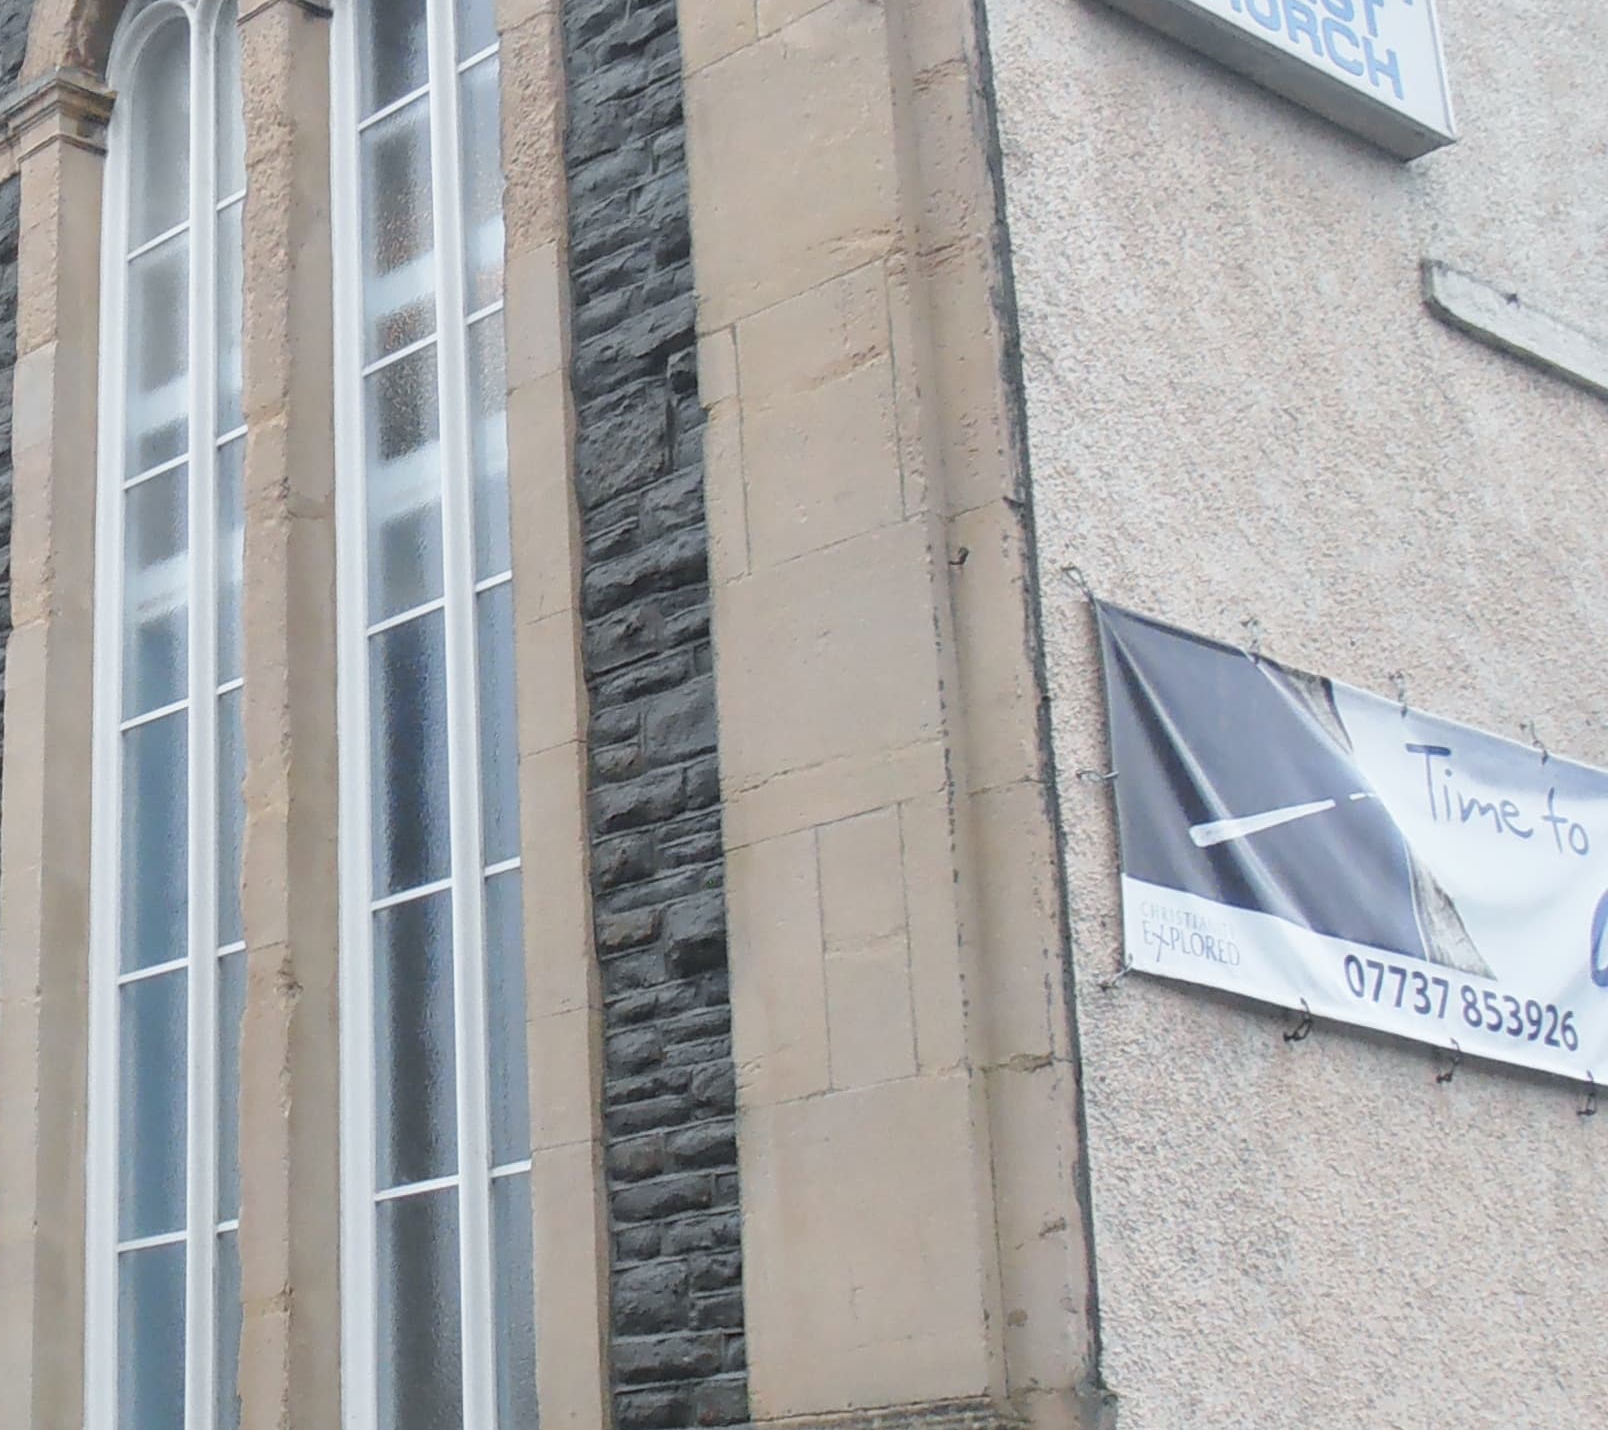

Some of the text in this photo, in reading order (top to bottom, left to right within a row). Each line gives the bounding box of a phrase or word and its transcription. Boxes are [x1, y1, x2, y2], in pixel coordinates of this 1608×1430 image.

[1405, 743, 1590, 855] Time to
[1343, 953, 1579, 1052] 07737 853926
